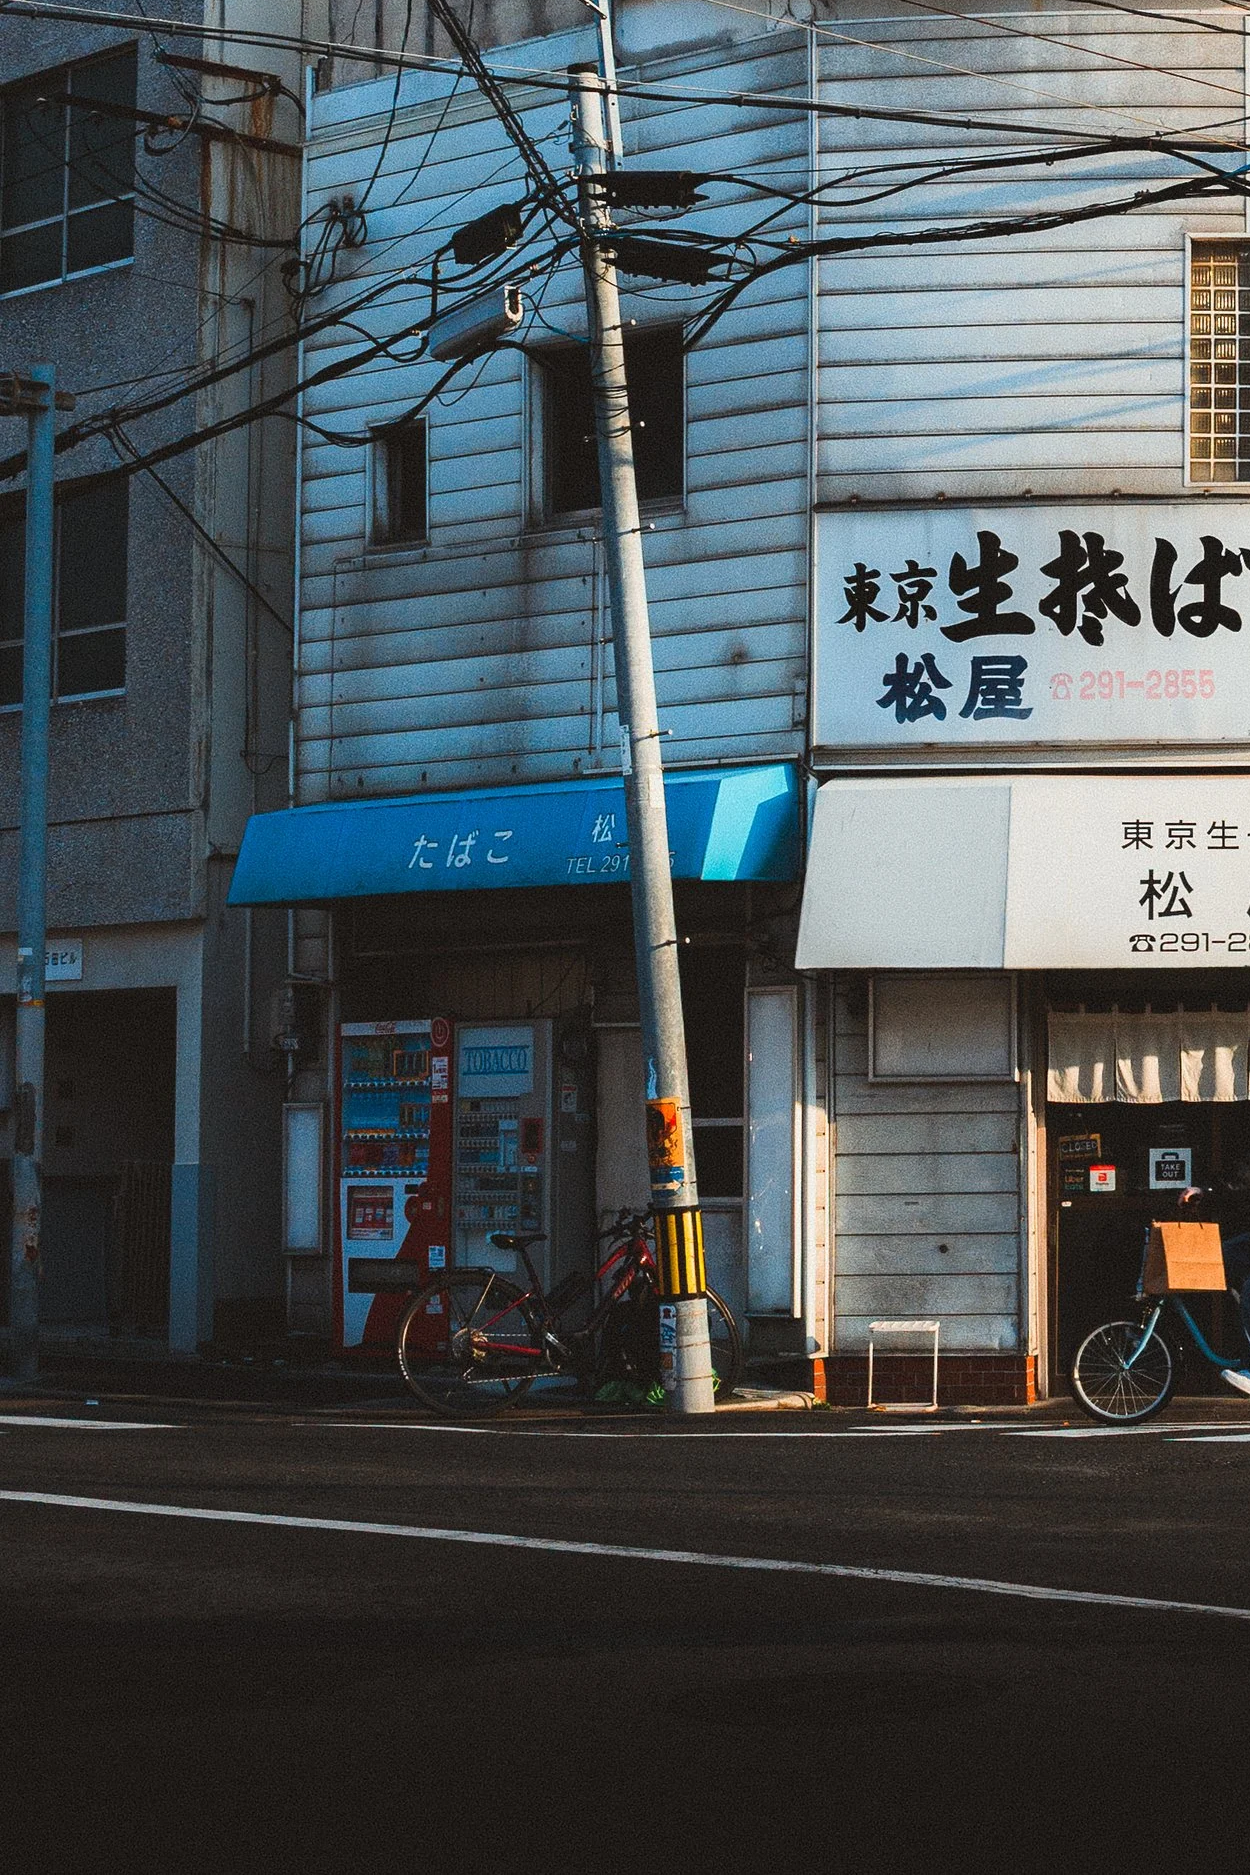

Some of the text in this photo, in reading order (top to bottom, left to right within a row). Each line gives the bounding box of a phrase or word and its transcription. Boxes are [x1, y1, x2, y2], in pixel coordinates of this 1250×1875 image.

[876, 652, 1034, 724] 松屋
[1079, 669, 1216, 700] 291-2855
[408, 830, 513, 869] たばこ
[566, 856, 596, 874] TEL
[463, 1048, 528, 1072] TOBACCO
[1160, 1163, 1181, 1171] TAKE
